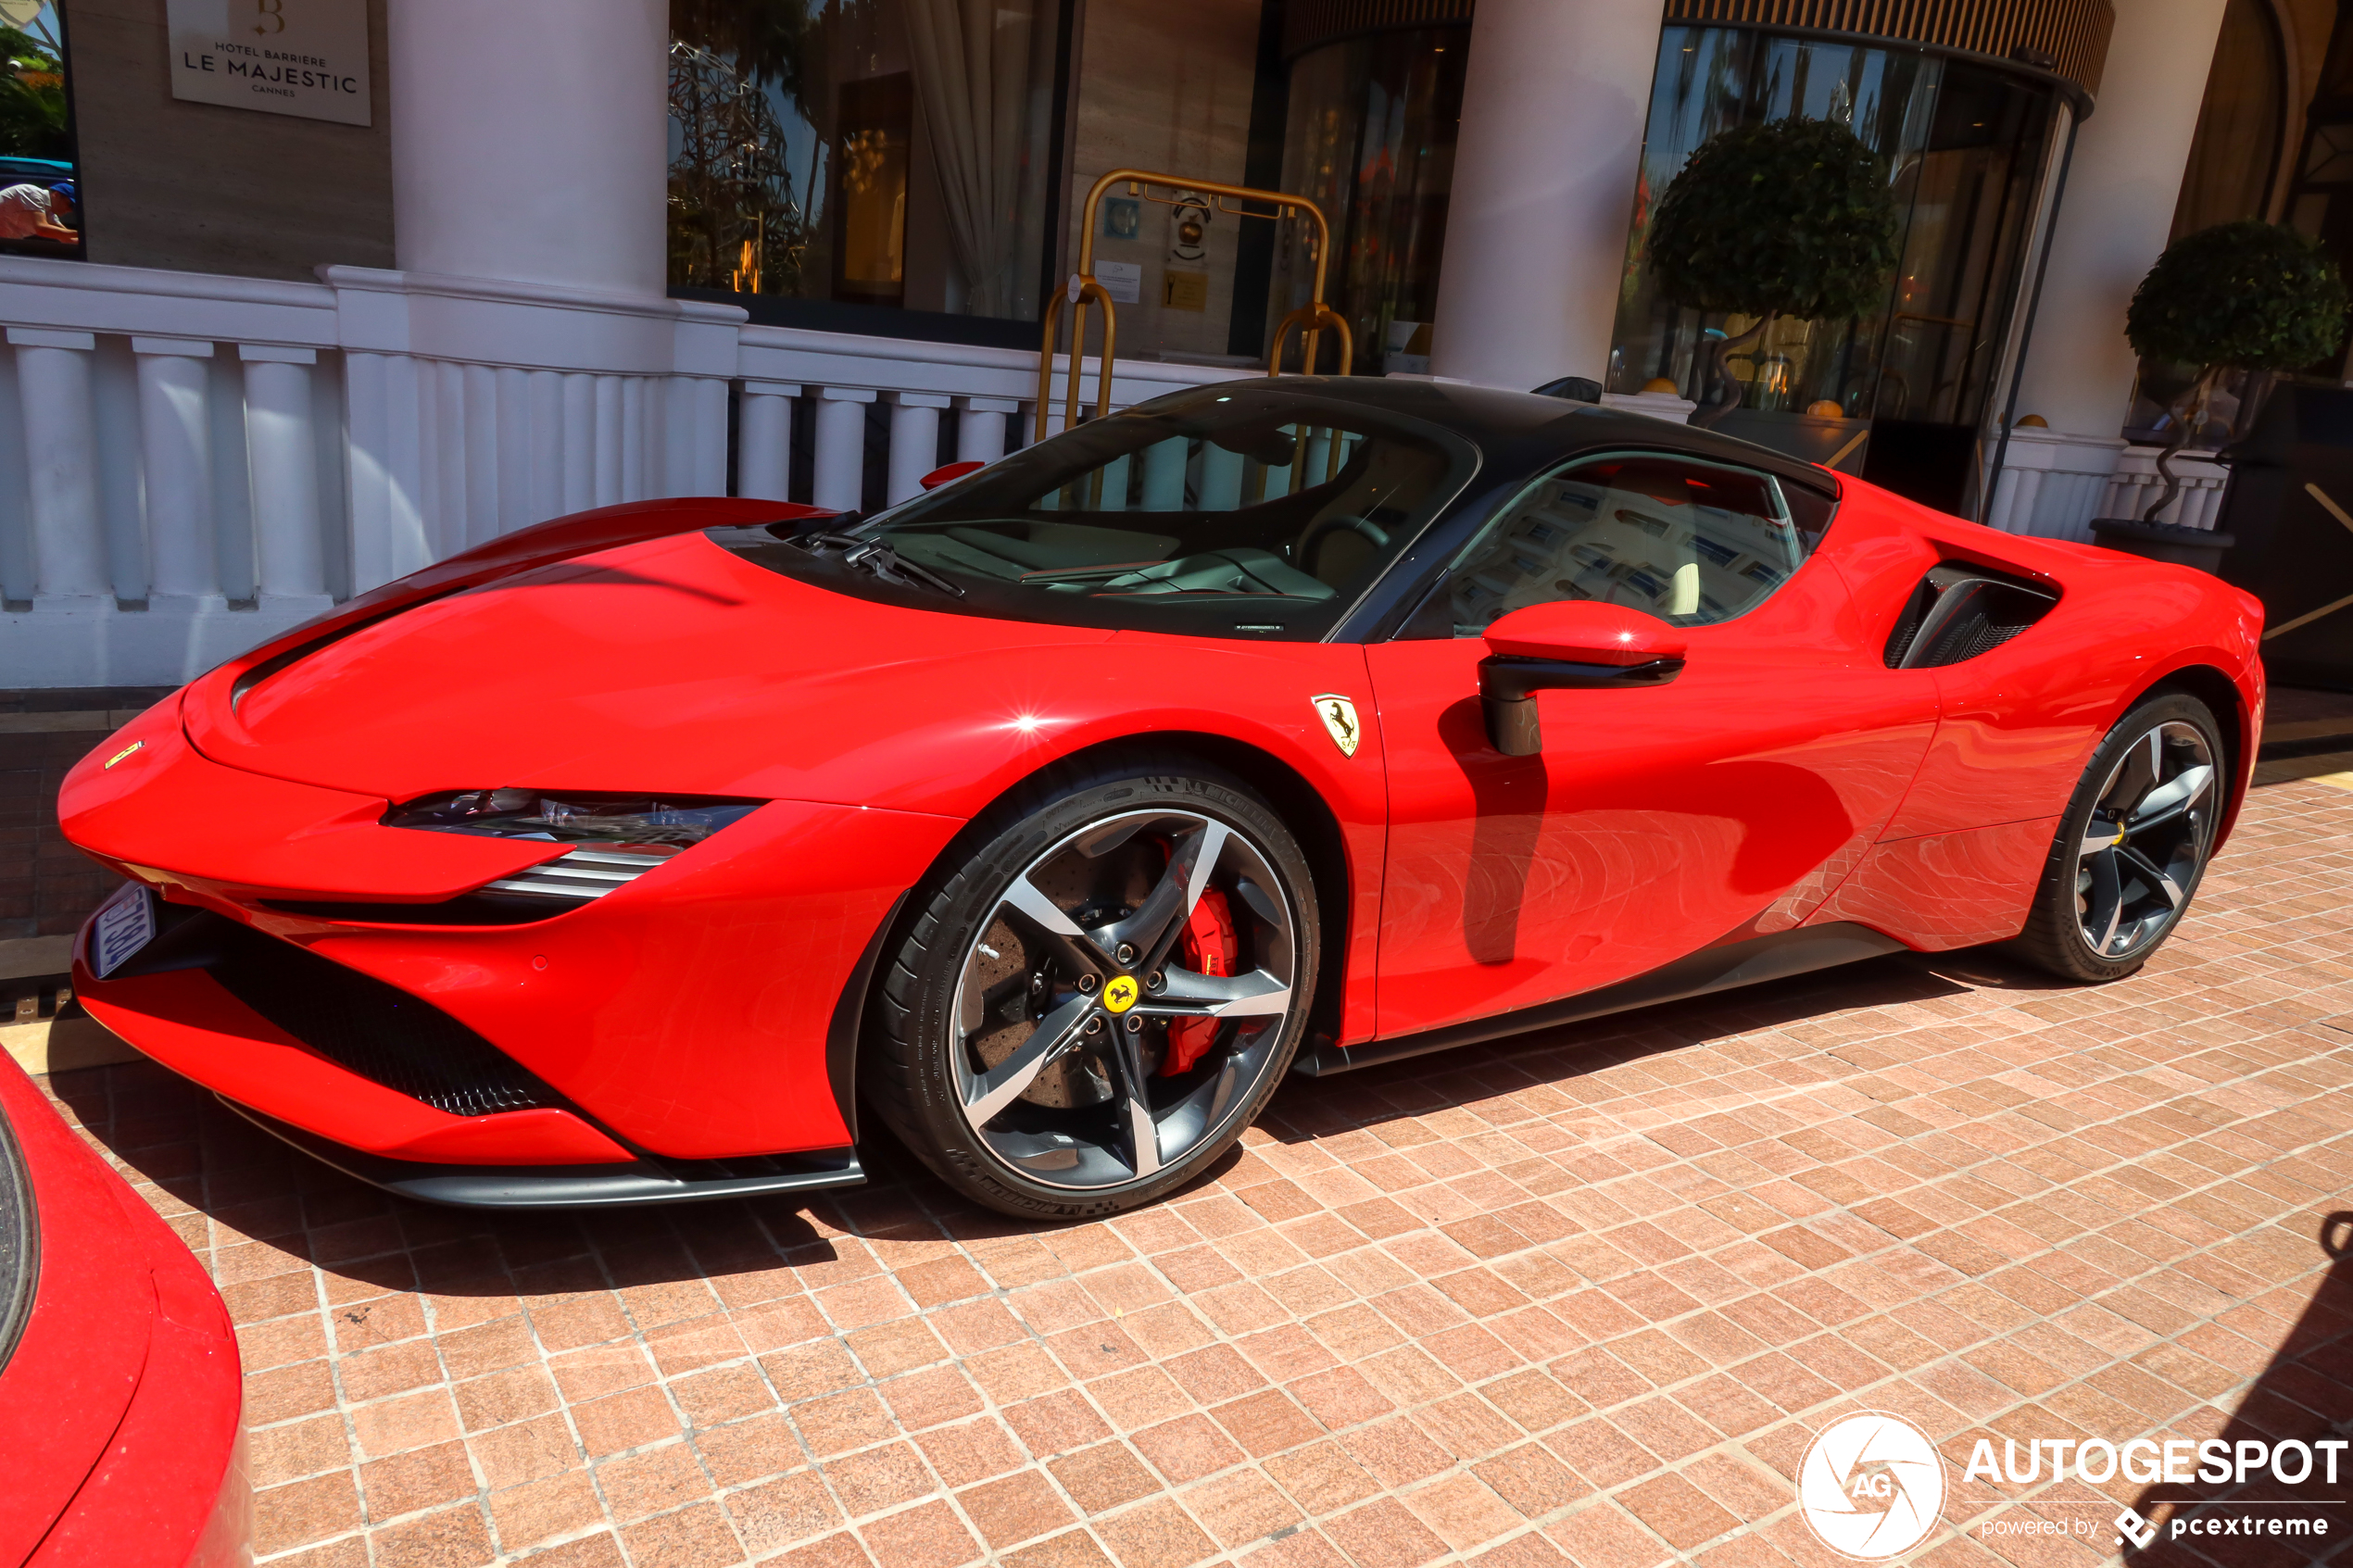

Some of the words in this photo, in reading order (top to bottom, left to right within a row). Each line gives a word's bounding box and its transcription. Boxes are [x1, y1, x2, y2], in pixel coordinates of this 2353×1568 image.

[184, 52, 215, 72] LE
[228, 58, 357, 94] MAJESTIC
[252, 84, 296, 98] CANNES
[977, 1175, 1061, 1215] MICHELIN
